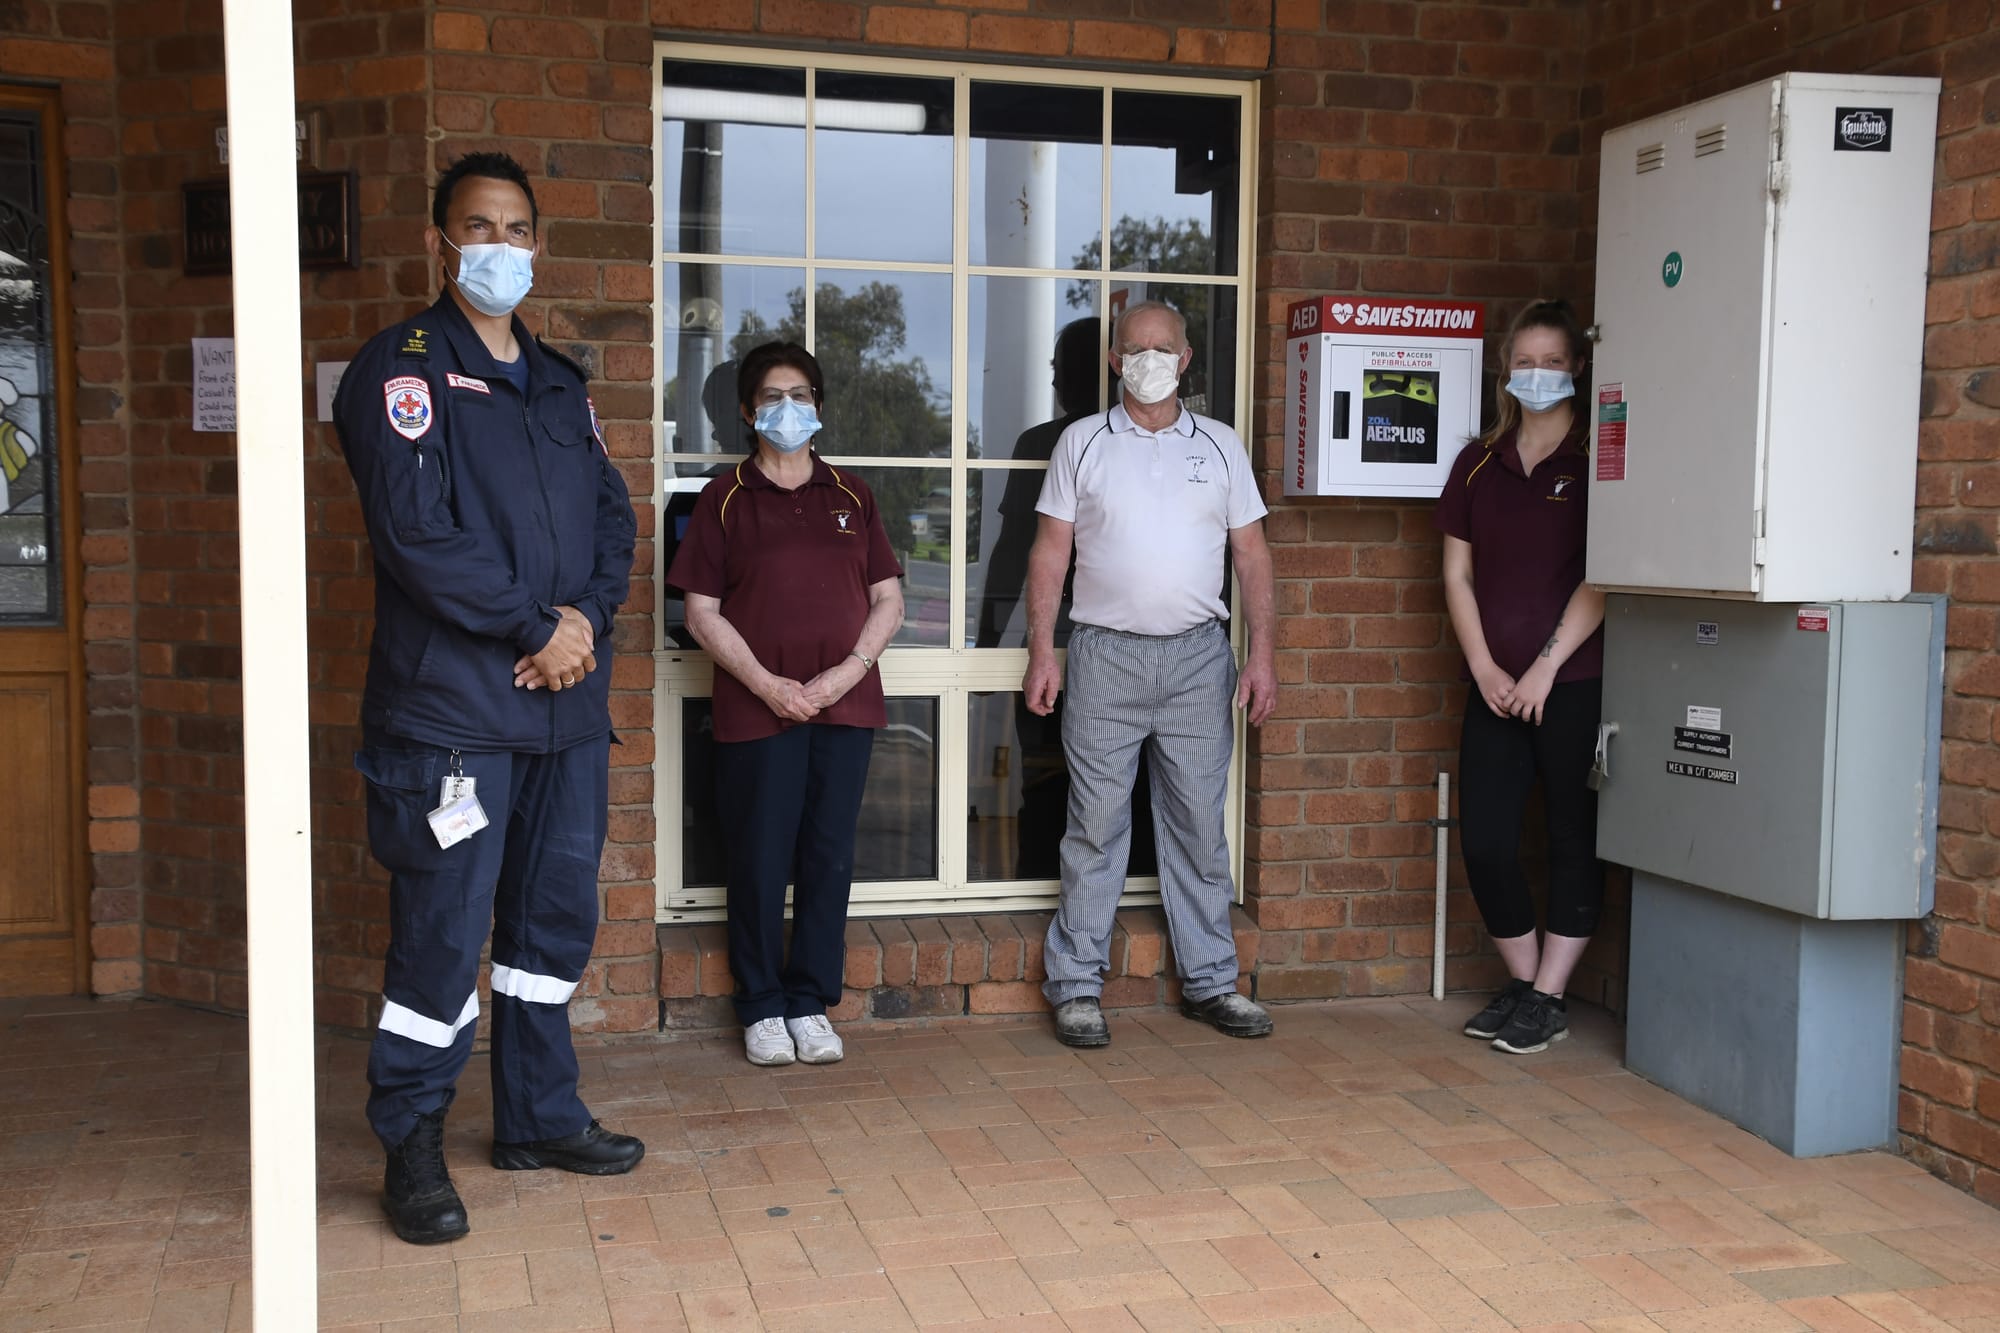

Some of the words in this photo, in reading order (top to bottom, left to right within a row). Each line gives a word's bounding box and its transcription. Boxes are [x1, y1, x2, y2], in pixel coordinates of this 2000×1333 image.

[1665, 260, 1680, 278] PV
[1292, 305, 1318, 332] AED
[1354, 303, 1476, 330] SAVESTATION
[200, 346, 234, 367] WANT
[1371, 359, 1433, 367] DEFIBRILLATOR
[1296, 369, 1308, 489] SAVESTATION
[1367, 416, 1392, 425] ZOLL
[1683, 730, 1698, 739] SUPPLY
[1699, 733, 1721, 742] AUTHORITY
[1677, 740, 1695, 749] CURRENT
[1696, 743, 1728, 755] TRANSFORMERS
[1687, 765, 1693, 775] IN
[1695, 767, 1705, 777] C/T
[1707, 768, 1735, 782] CHAMBER
